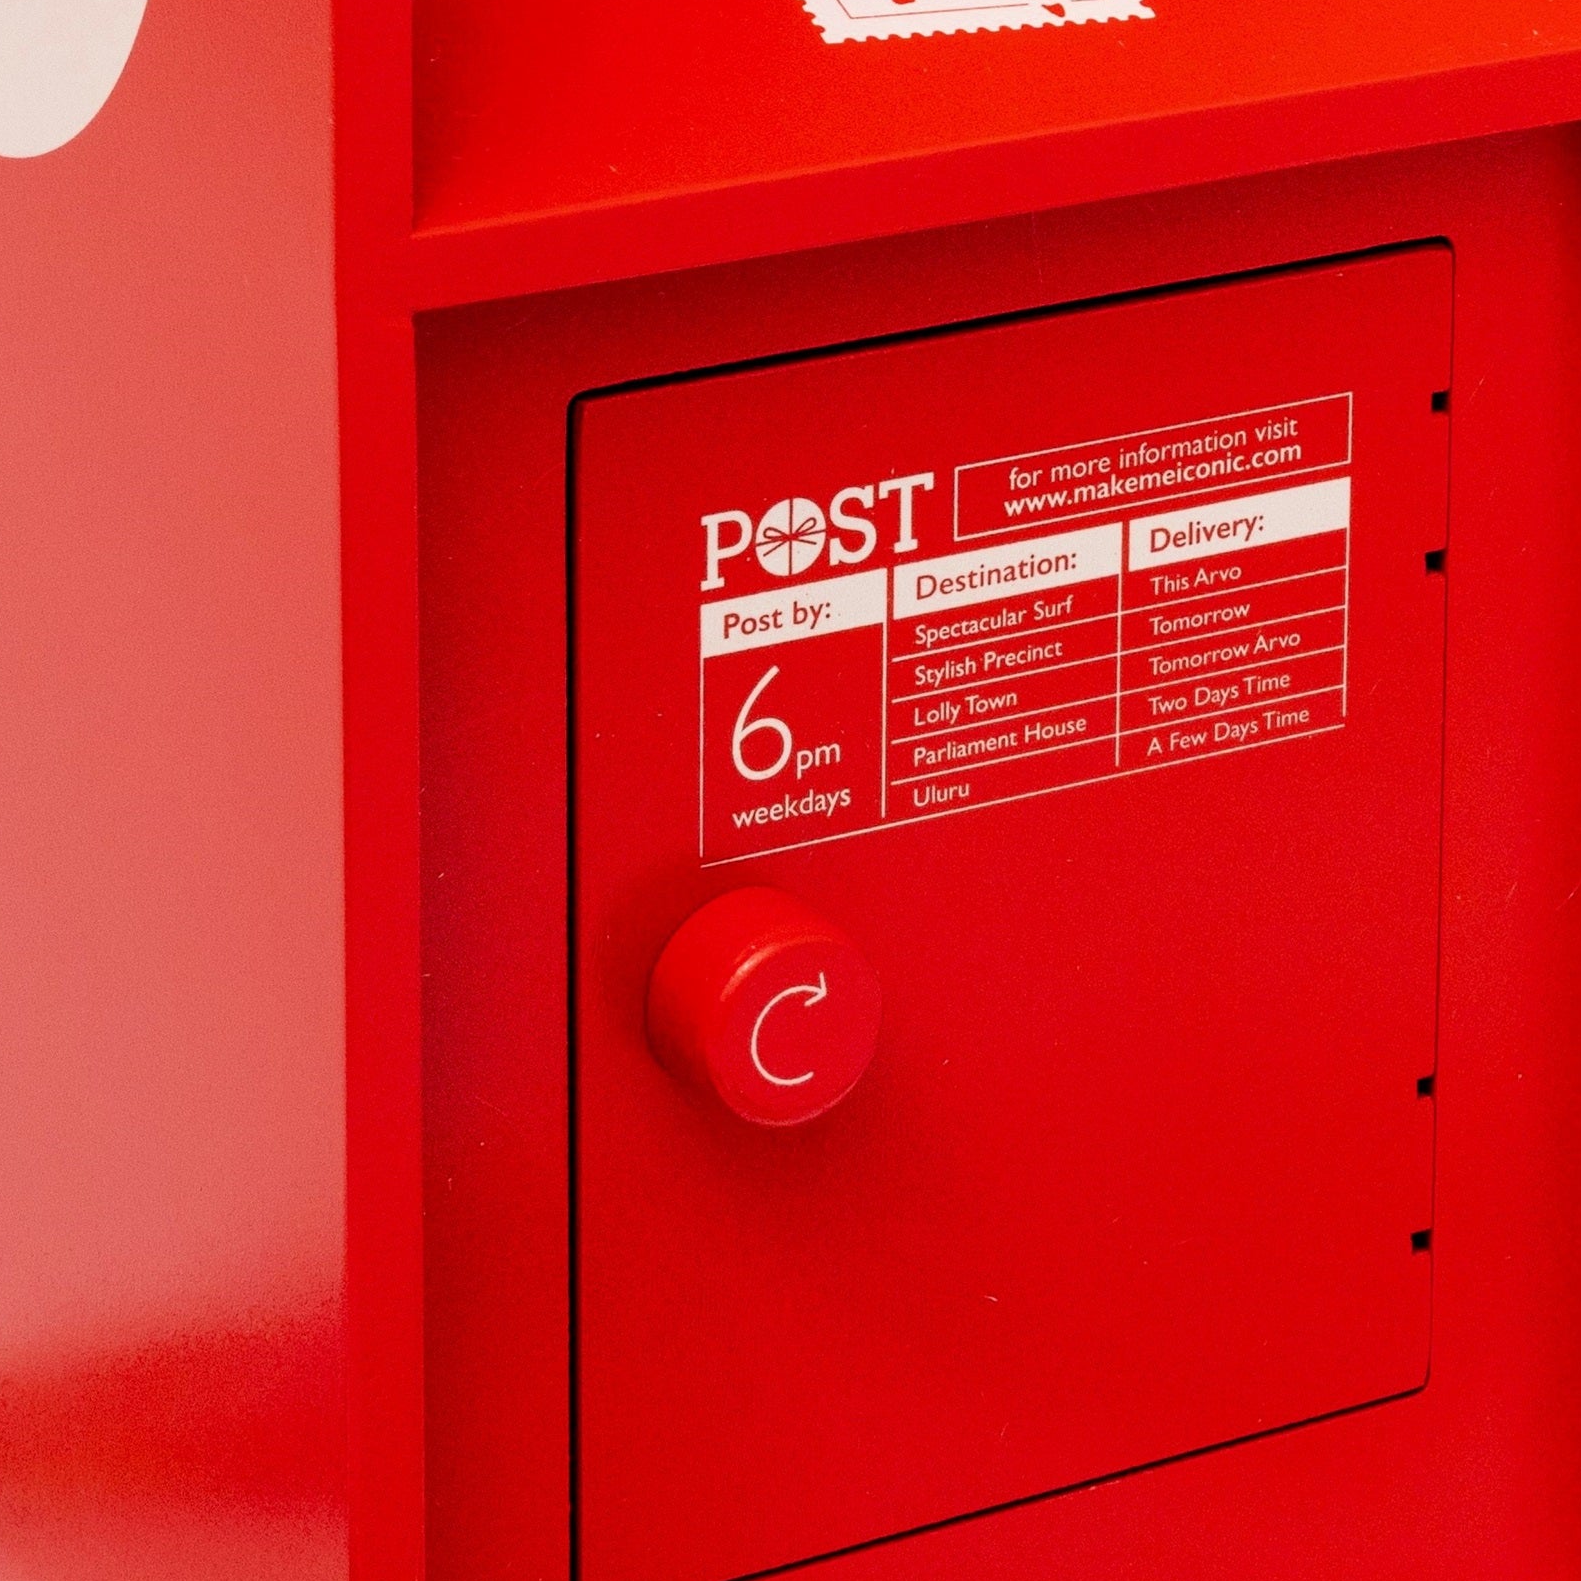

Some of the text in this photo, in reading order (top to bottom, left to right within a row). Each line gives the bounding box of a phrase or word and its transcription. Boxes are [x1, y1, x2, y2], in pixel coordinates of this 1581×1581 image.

[1009, 417, 1298, 491] for more information visit
[1003, 444, 1301, 517] www.makemeiconic.com
[700, 471, 935, 592] POST
[1150, 515, 1264, 554] Delivery:
[917, 552, 1077, 600] Destination:
[1151, 565, 1241, 596] This Arvo
[723, 601, 832, 640] Post by:
[915, 595, 1074, 648] Spectacular Surf
[1149, 603, 1251, 636] Tomorrow
[915, 641, 1063, 687] Stylish Precinct
[1149, 633, 1301, 676] Tomorrow Arvo
[914, 692, 1017, 727] Lolly Town
[1148, 673, 1290, 715] Two Days Time
[914, 718, 1086, 767] Parliament House
[1147, 708, 1309, 756] A Few Days Time
[733, 786, 851, 829] weekdays
[913, 784, 969, 807] Uluru
